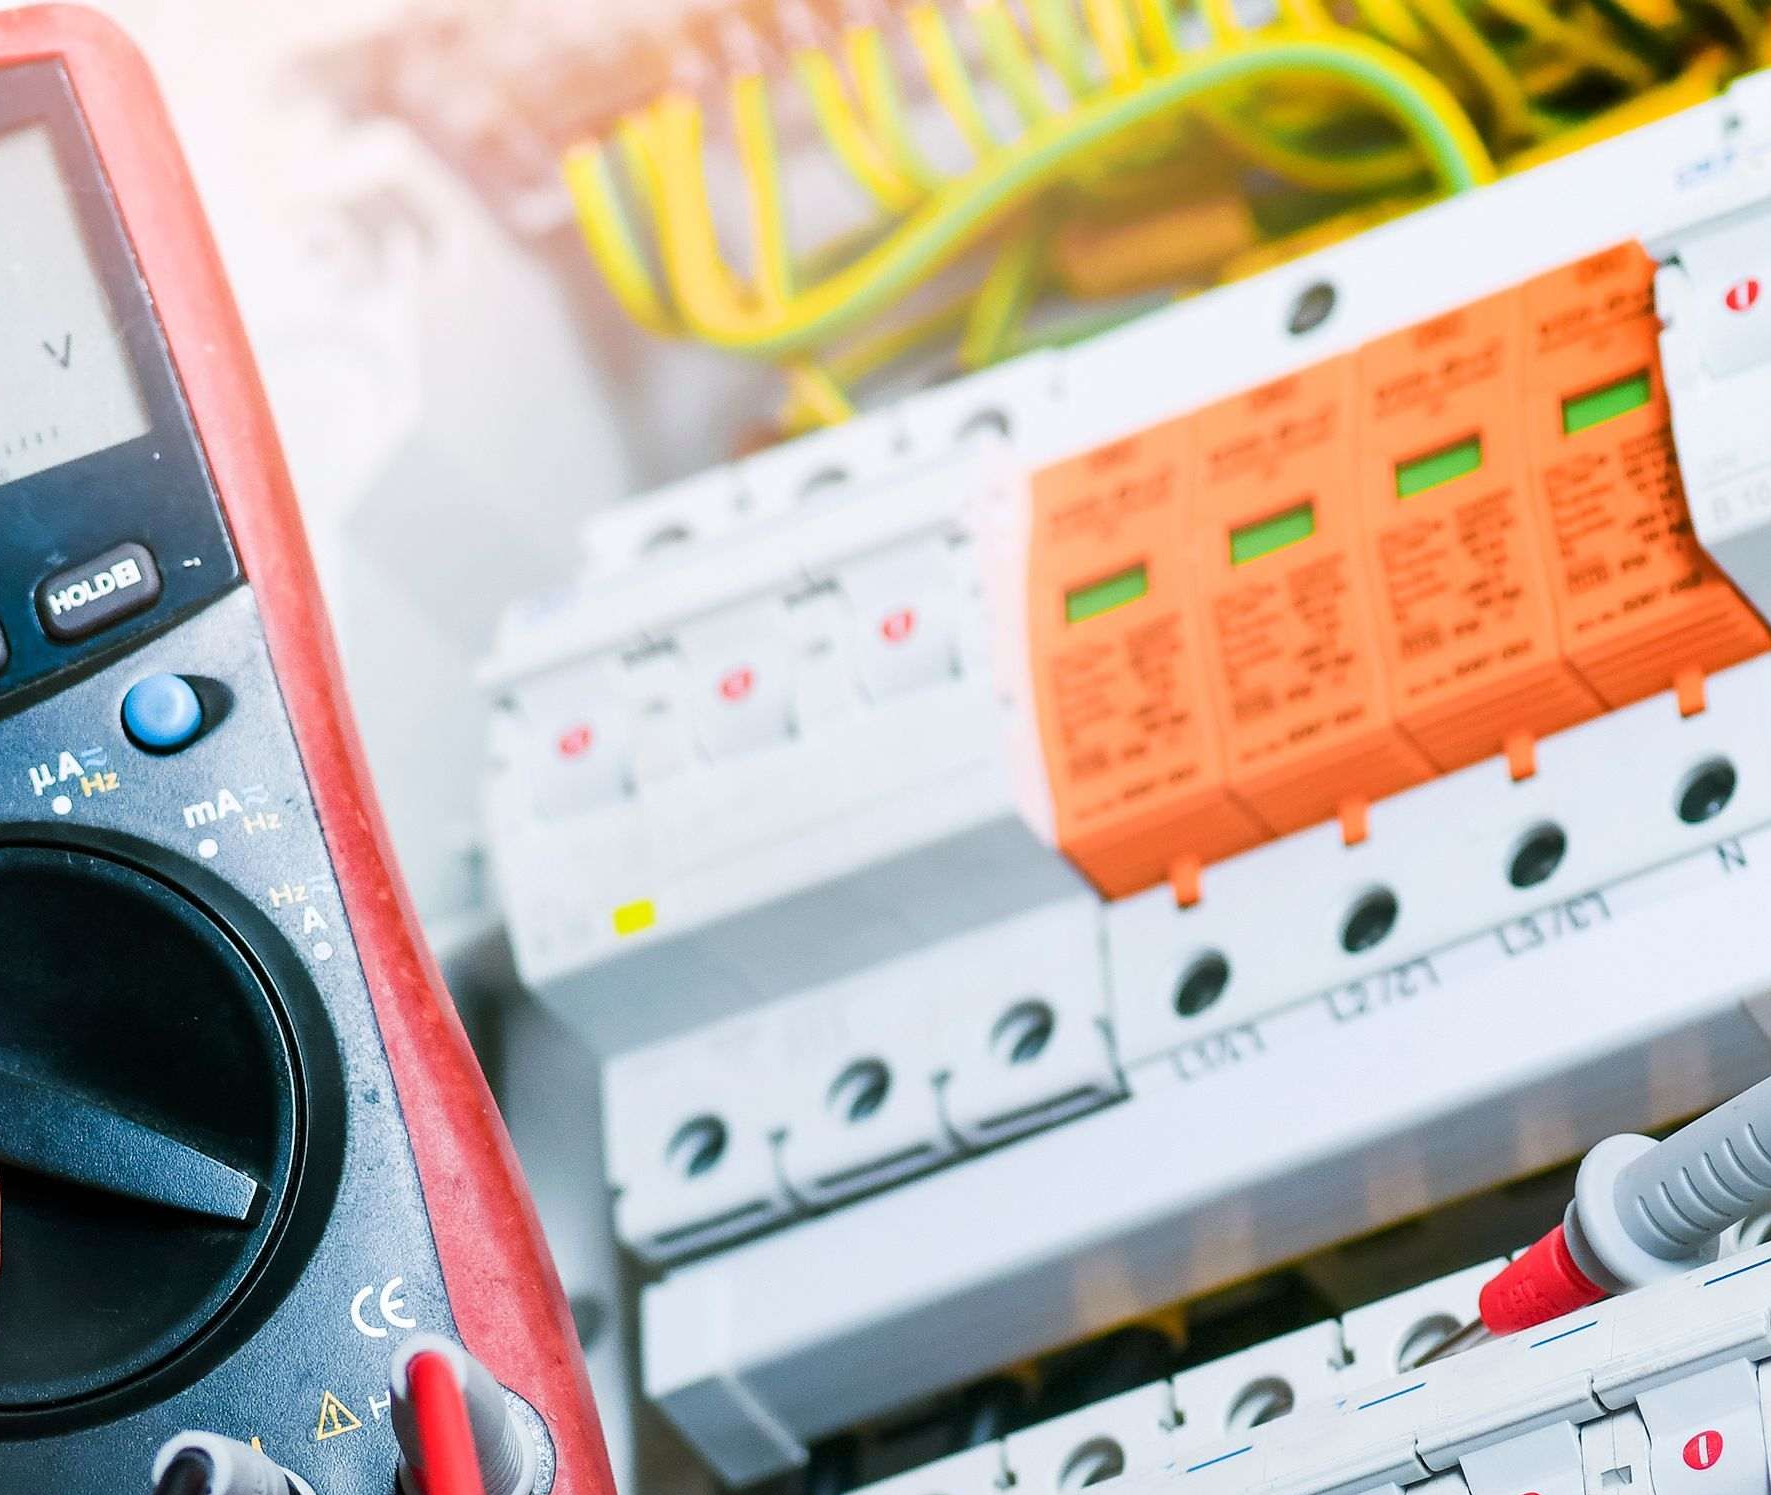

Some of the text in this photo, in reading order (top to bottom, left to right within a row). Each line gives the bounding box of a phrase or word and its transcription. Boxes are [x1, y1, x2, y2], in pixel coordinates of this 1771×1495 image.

[43, 331, 74, 369] V
[79, 770, 121, 798] Hz
[183, 788, 244, 829] mA
[243, 810, 282, 835] Hz
[1716, 840, 1749, 875] N
[303, 905, 327, 935] A
[350, 1275, 417, 1339] CE
